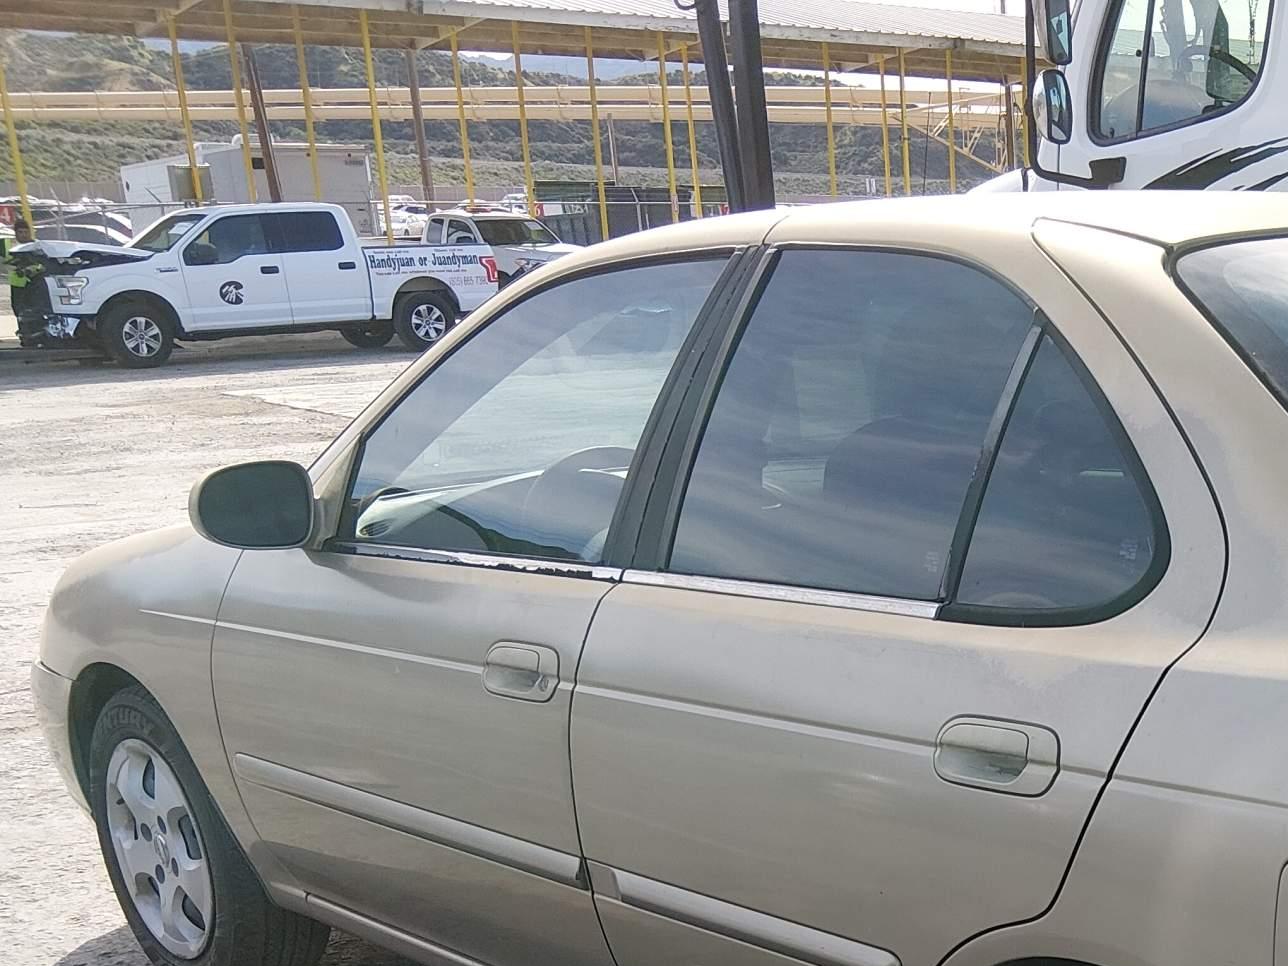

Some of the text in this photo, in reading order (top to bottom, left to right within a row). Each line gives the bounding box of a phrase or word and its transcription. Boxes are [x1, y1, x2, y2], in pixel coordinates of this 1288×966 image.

[368, 252, 479, 272] Handyjuan or Juandyman
